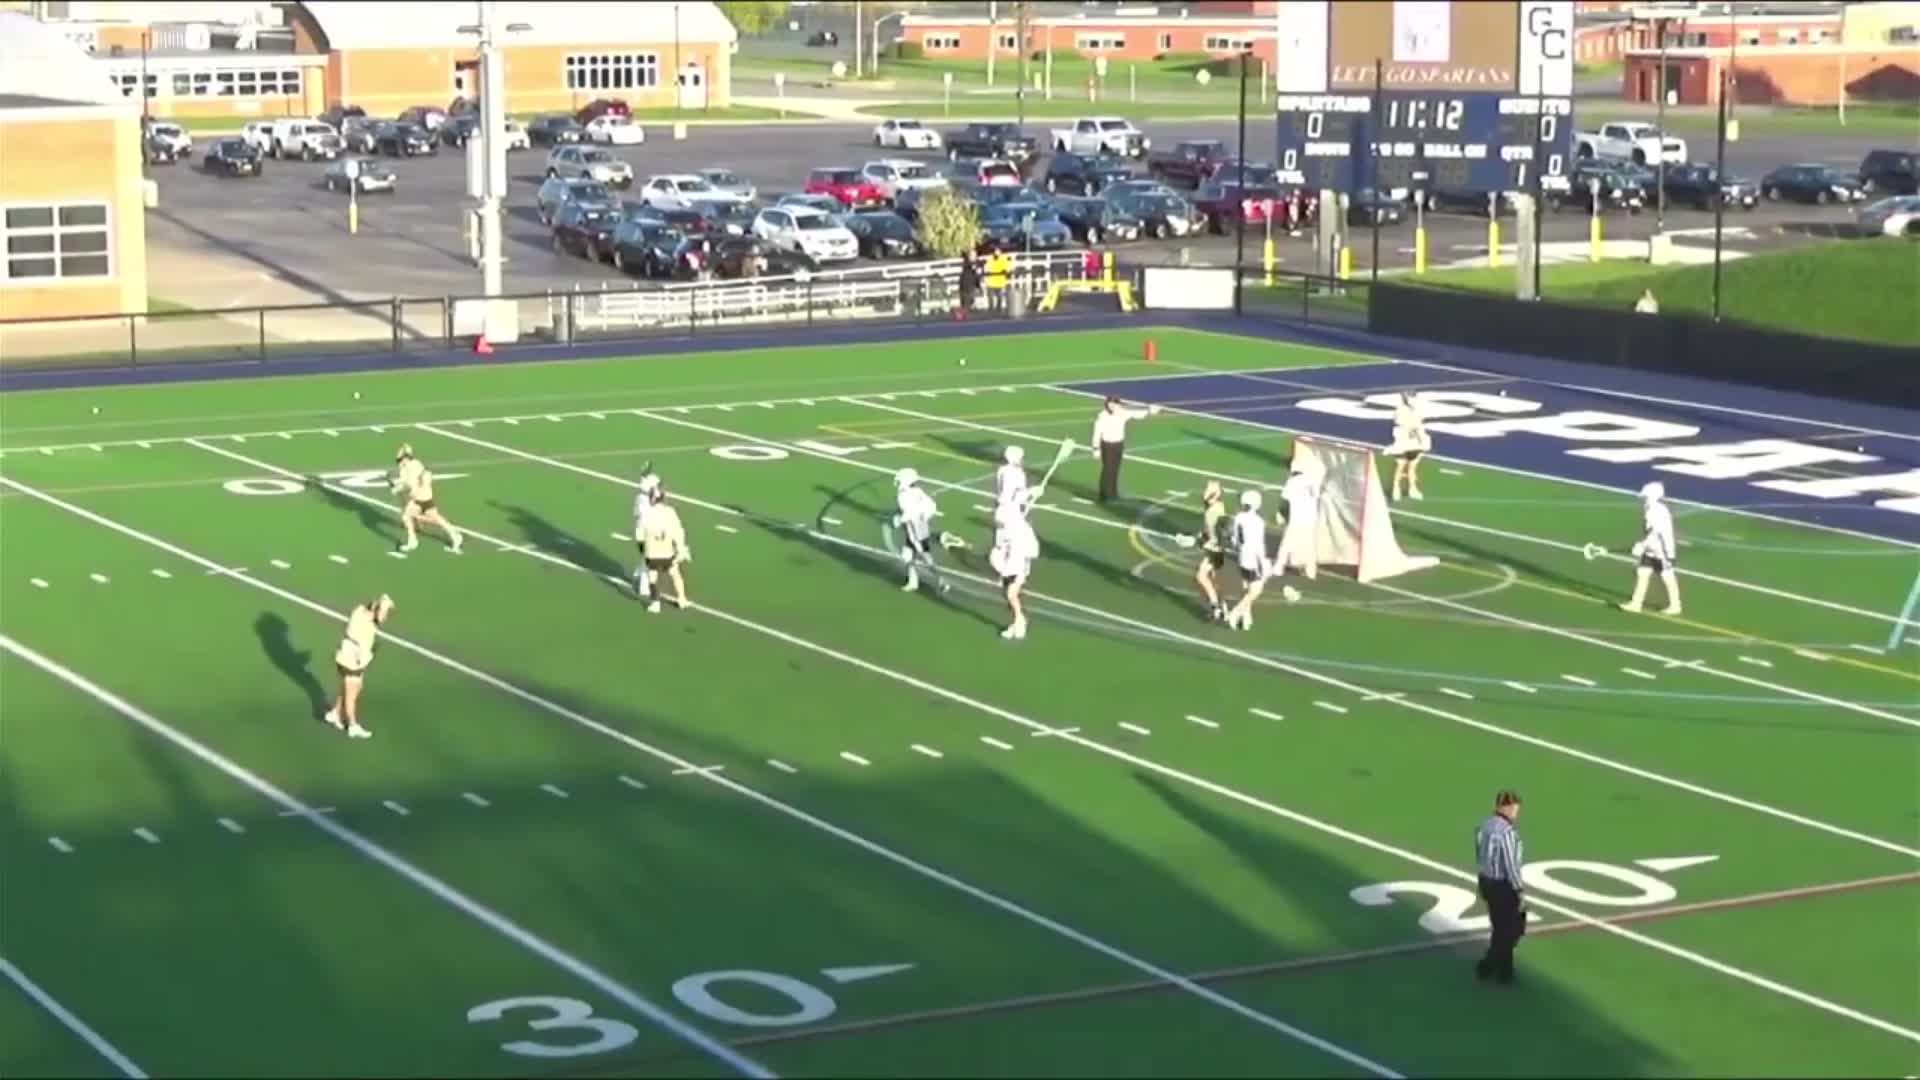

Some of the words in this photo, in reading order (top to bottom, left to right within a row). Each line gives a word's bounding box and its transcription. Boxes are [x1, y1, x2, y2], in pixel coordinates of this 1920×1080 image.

[1307, 112, 1323, 138] 0
[1389, 99, 1464, 131] 11:12
[1541, 115, 1556, 141] 0
[1284, 149, 1297, 170] 0
[1501, 145, 1533, 162] QTR
[1548, 154, 1562, 175] 0
[1518, 163, 1525, 186] 1
[1349, 858, 1680, 935] 20
[465, 967, 839, 1057] 30
